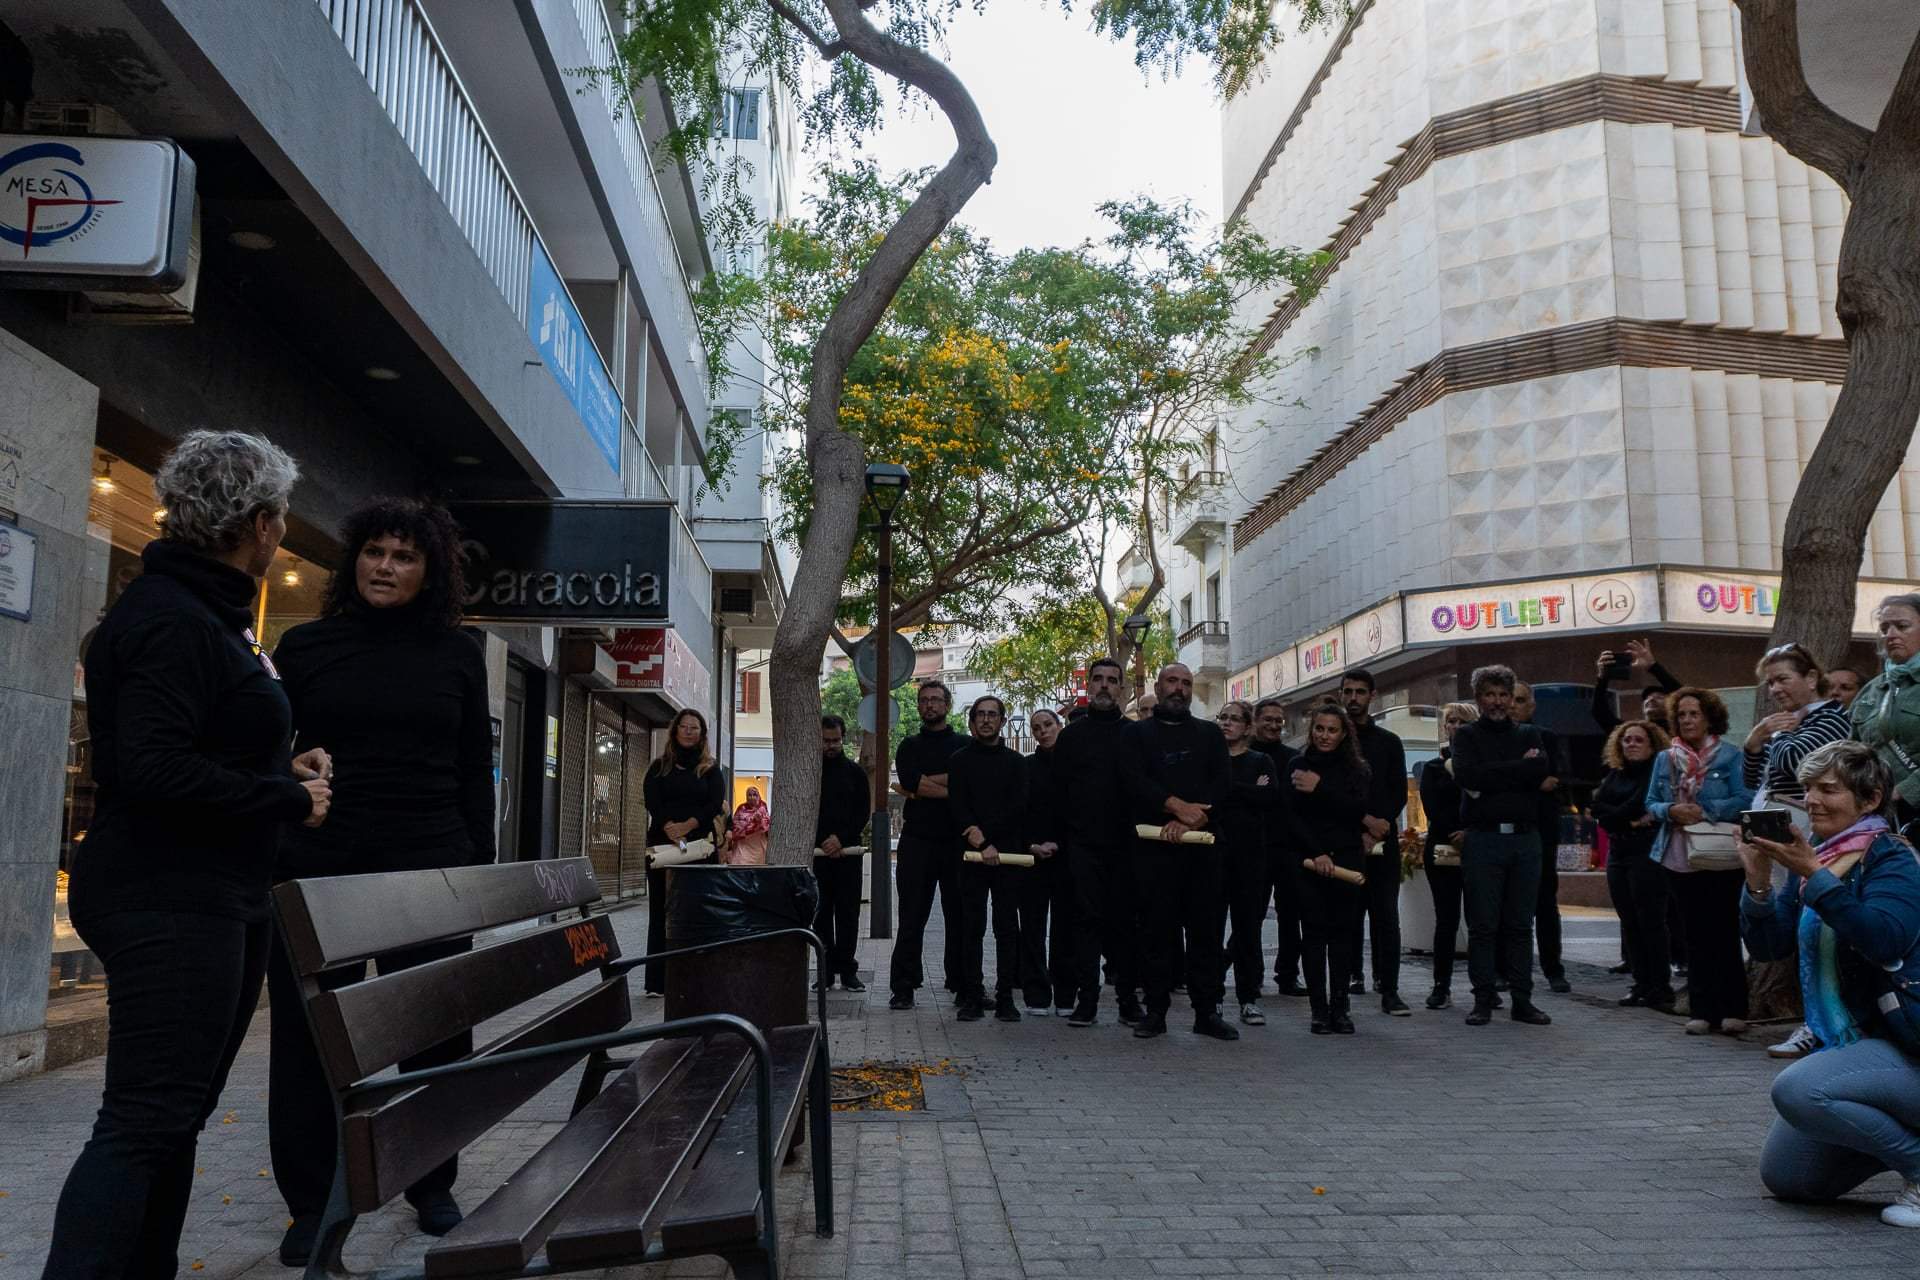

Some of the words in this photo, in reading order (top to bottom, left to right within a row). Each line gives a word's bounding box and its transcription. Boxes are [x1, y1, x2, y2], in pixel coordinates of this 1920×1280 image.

[6, 176, 69, 198] MESA
[1431, 595, 1564, 632] OUTLET
[1697, 582, 1781, 616] OUTL
[1305, 638, 1338, 673] OUTLET
[637, 679, 660, 687] DIGITAL
[1231, 675, 1255, 700] OUTLET
